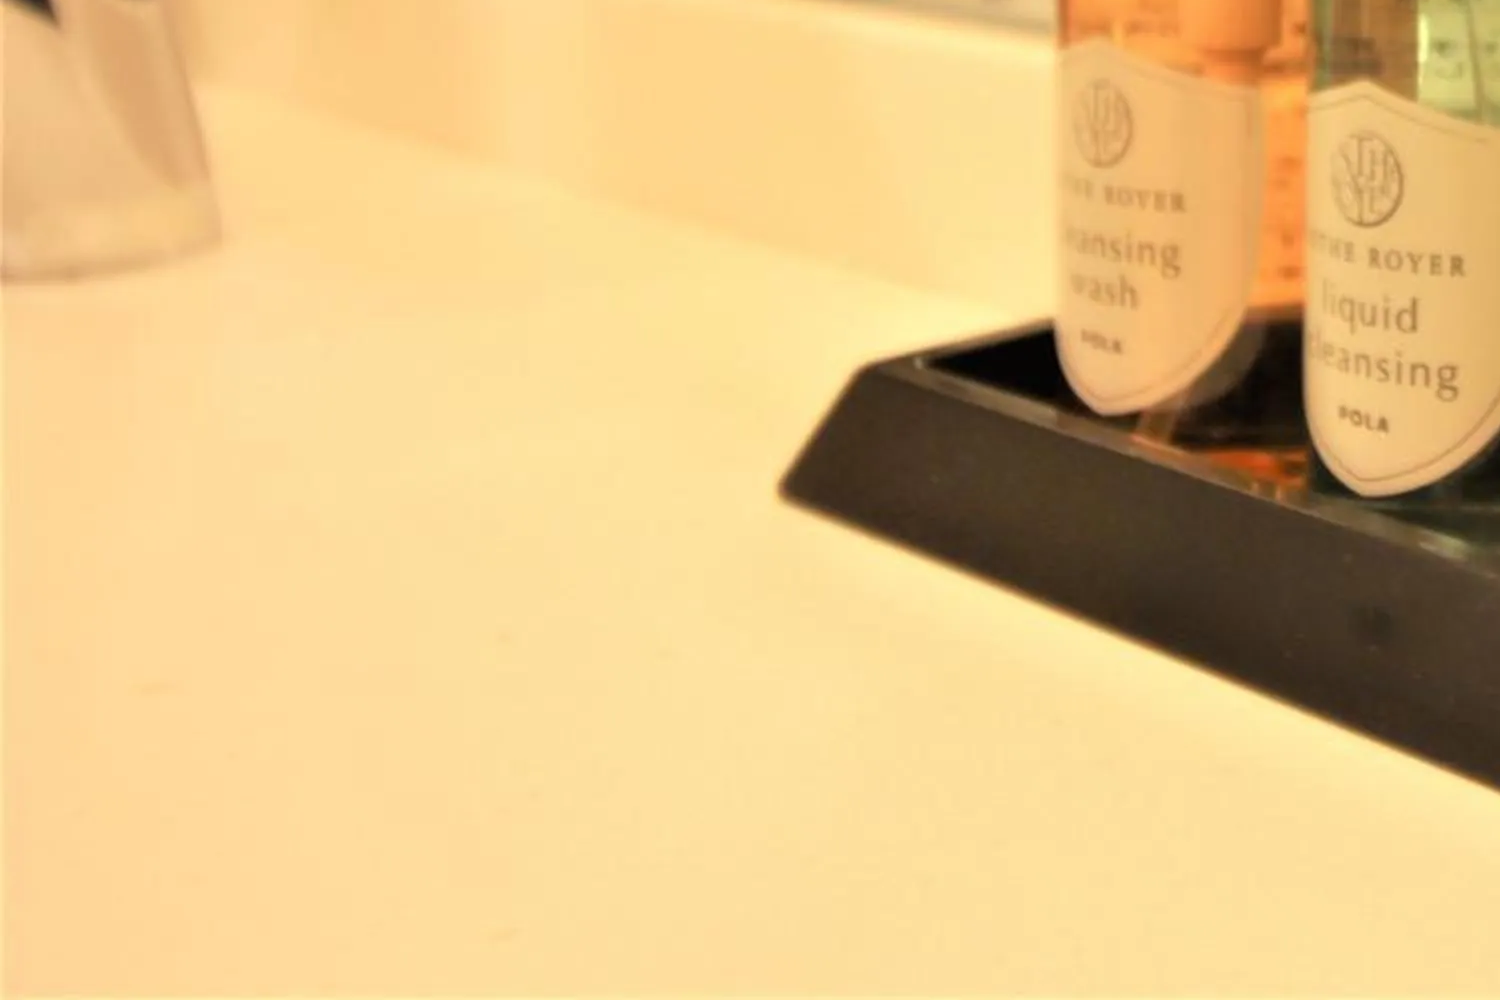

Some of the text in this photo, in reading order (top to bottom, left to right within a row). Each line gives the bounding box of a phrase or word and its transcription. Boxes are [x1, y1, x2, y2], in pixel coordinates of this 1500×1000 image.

[1368, 247, 1468, 278] ROYER
[1323, 278, 1420, 335] liquid
[1338, 404, 1390, 434] POLA
